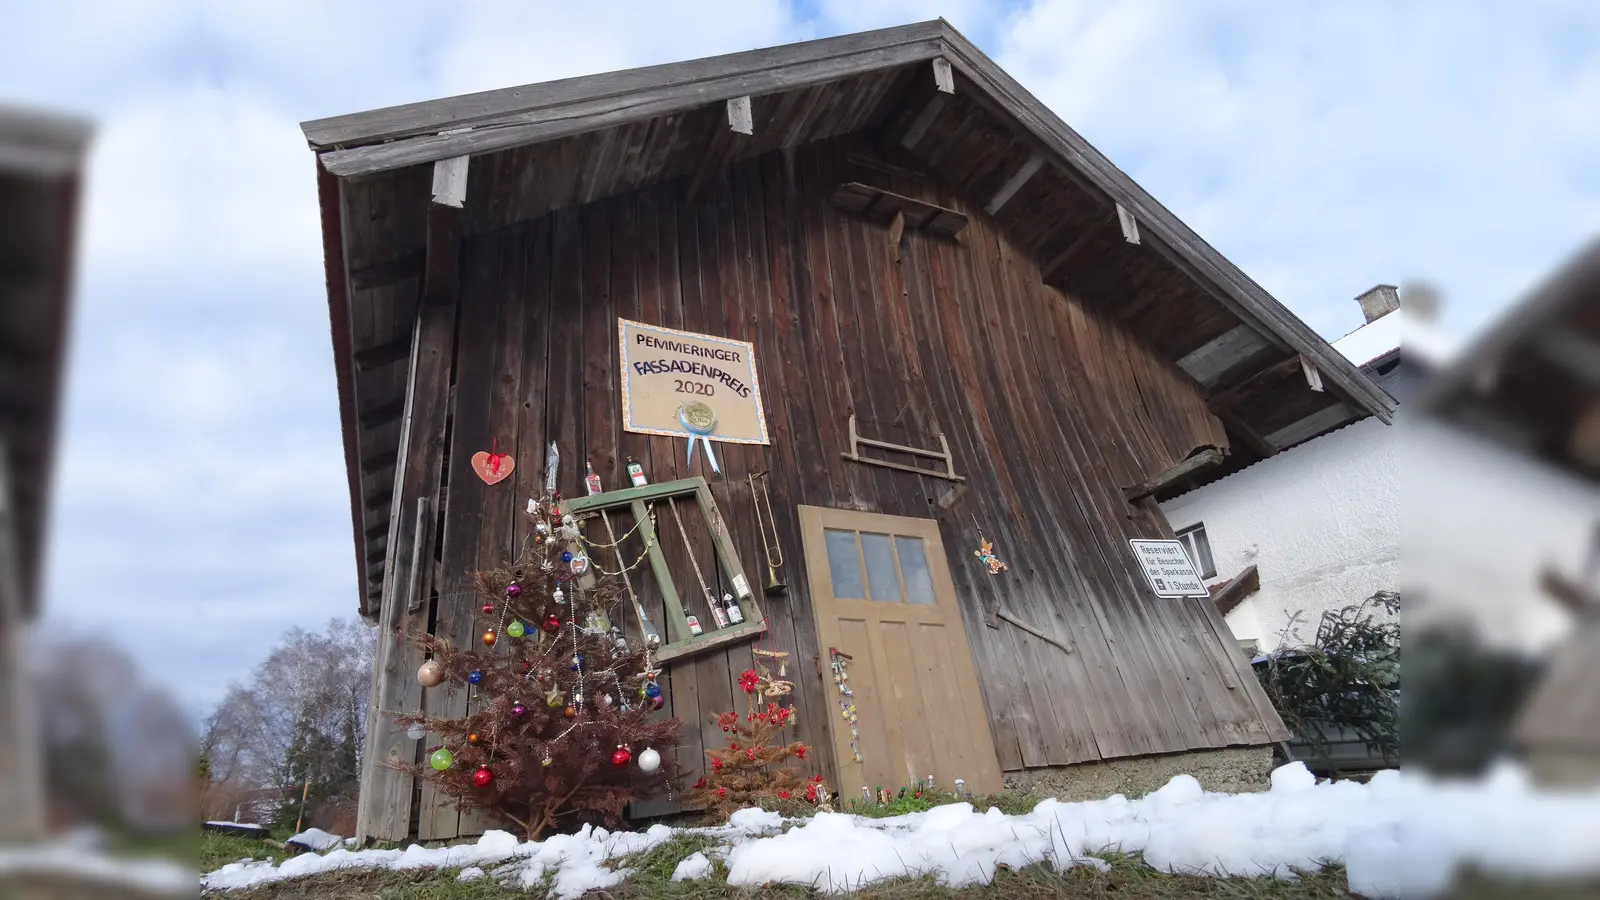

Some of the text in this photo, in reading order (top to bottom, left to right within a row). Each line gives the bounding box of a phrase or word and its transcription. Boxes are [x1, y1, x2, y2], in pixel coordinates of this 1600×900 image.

[636, 334, 741, 363] PEMMERINGER
[633, 359, 752, 399] FASSADENPREIS
[674, 379, 715, 397] 2020
[1139, 545, 1180, 554] Reserviert
[1156, 557, 1185, 565] Besucher
[1161, 568, 1194, 577] Sparkasse
[1167, 581, 1200, 590] 1 Stunde
